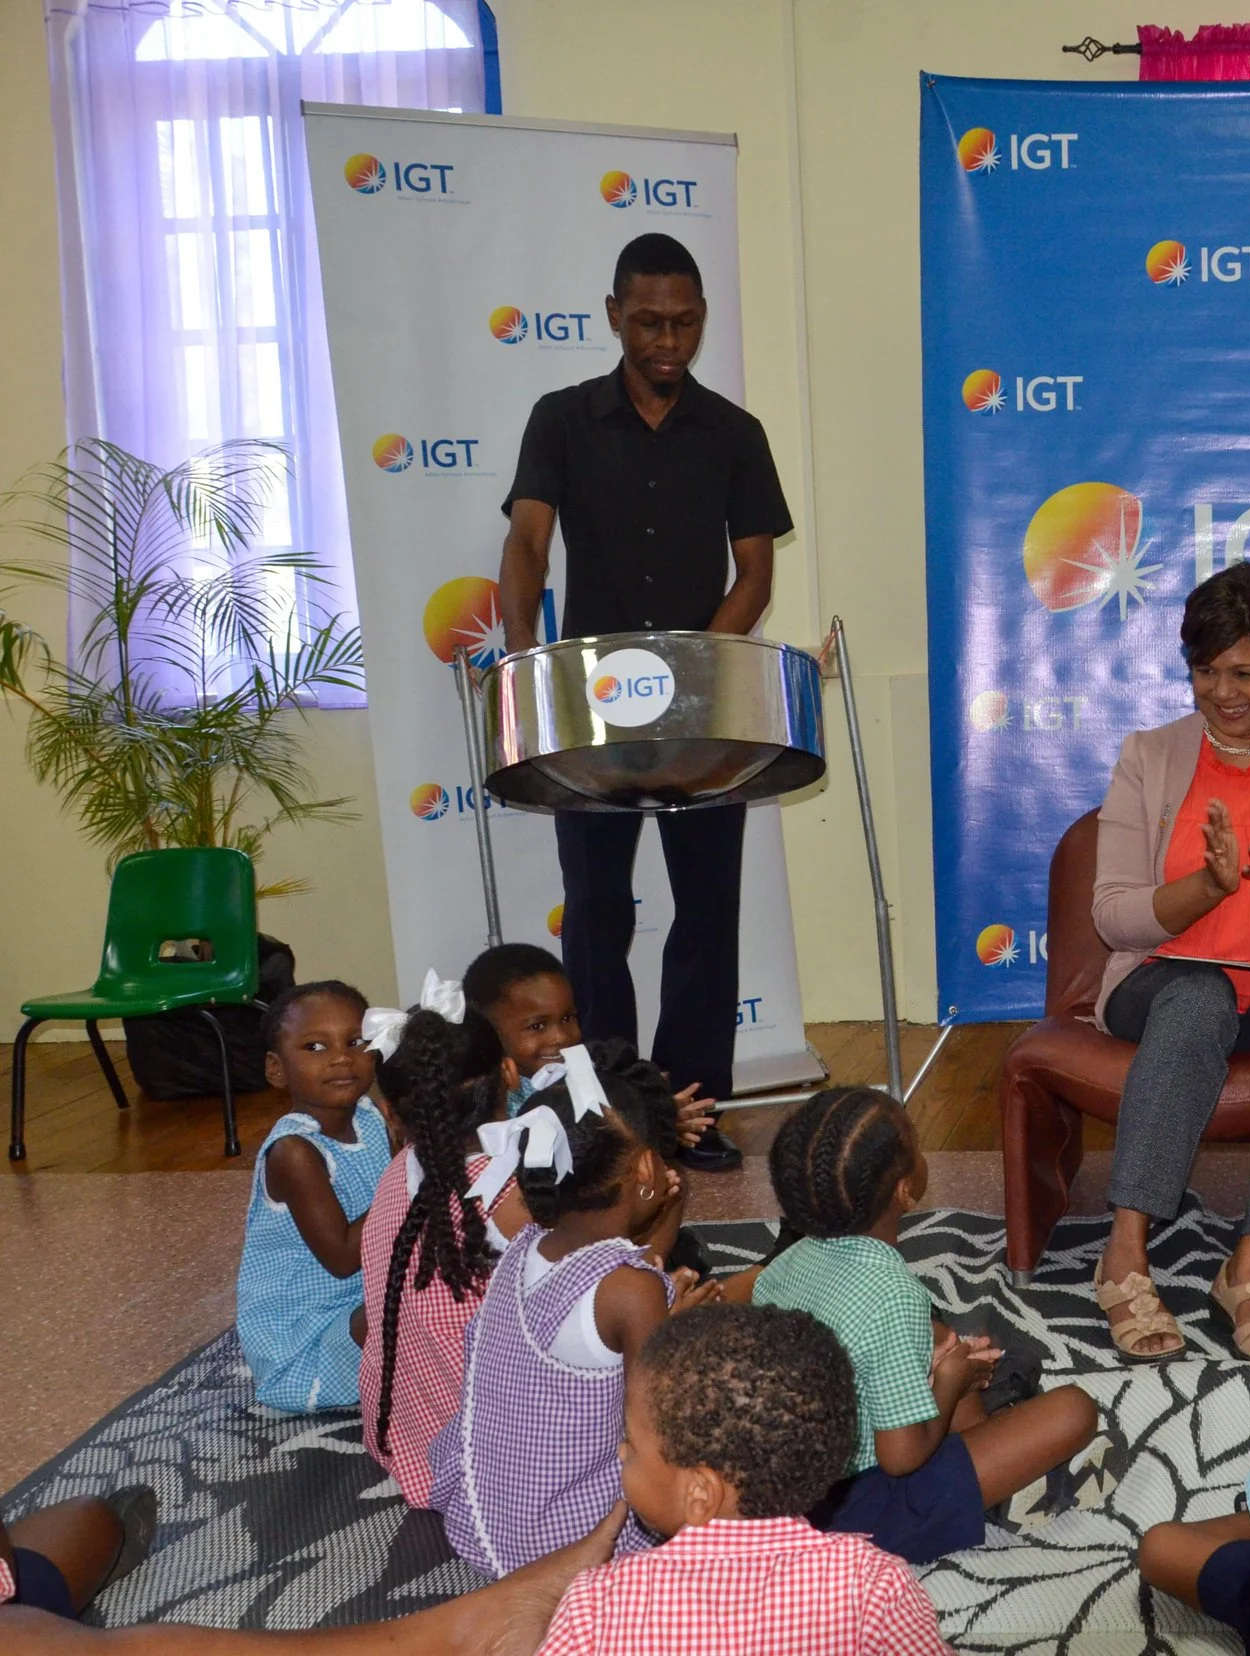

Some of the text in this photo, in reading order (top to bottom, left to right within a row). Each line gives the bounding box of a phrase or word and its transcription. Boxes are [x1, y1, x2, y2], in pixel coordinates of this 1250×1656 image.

[1011, 134, 1078, 170] IGT
[394, 162, 454, 193] IGT
[644, 179, 697, 207] IGT
[535, 312, 591, 341] IGT
[1016, 376, 1083, 412] IGT
[421, 439, 479, 467] IGT
[626, 675, 669, 698] IGT
